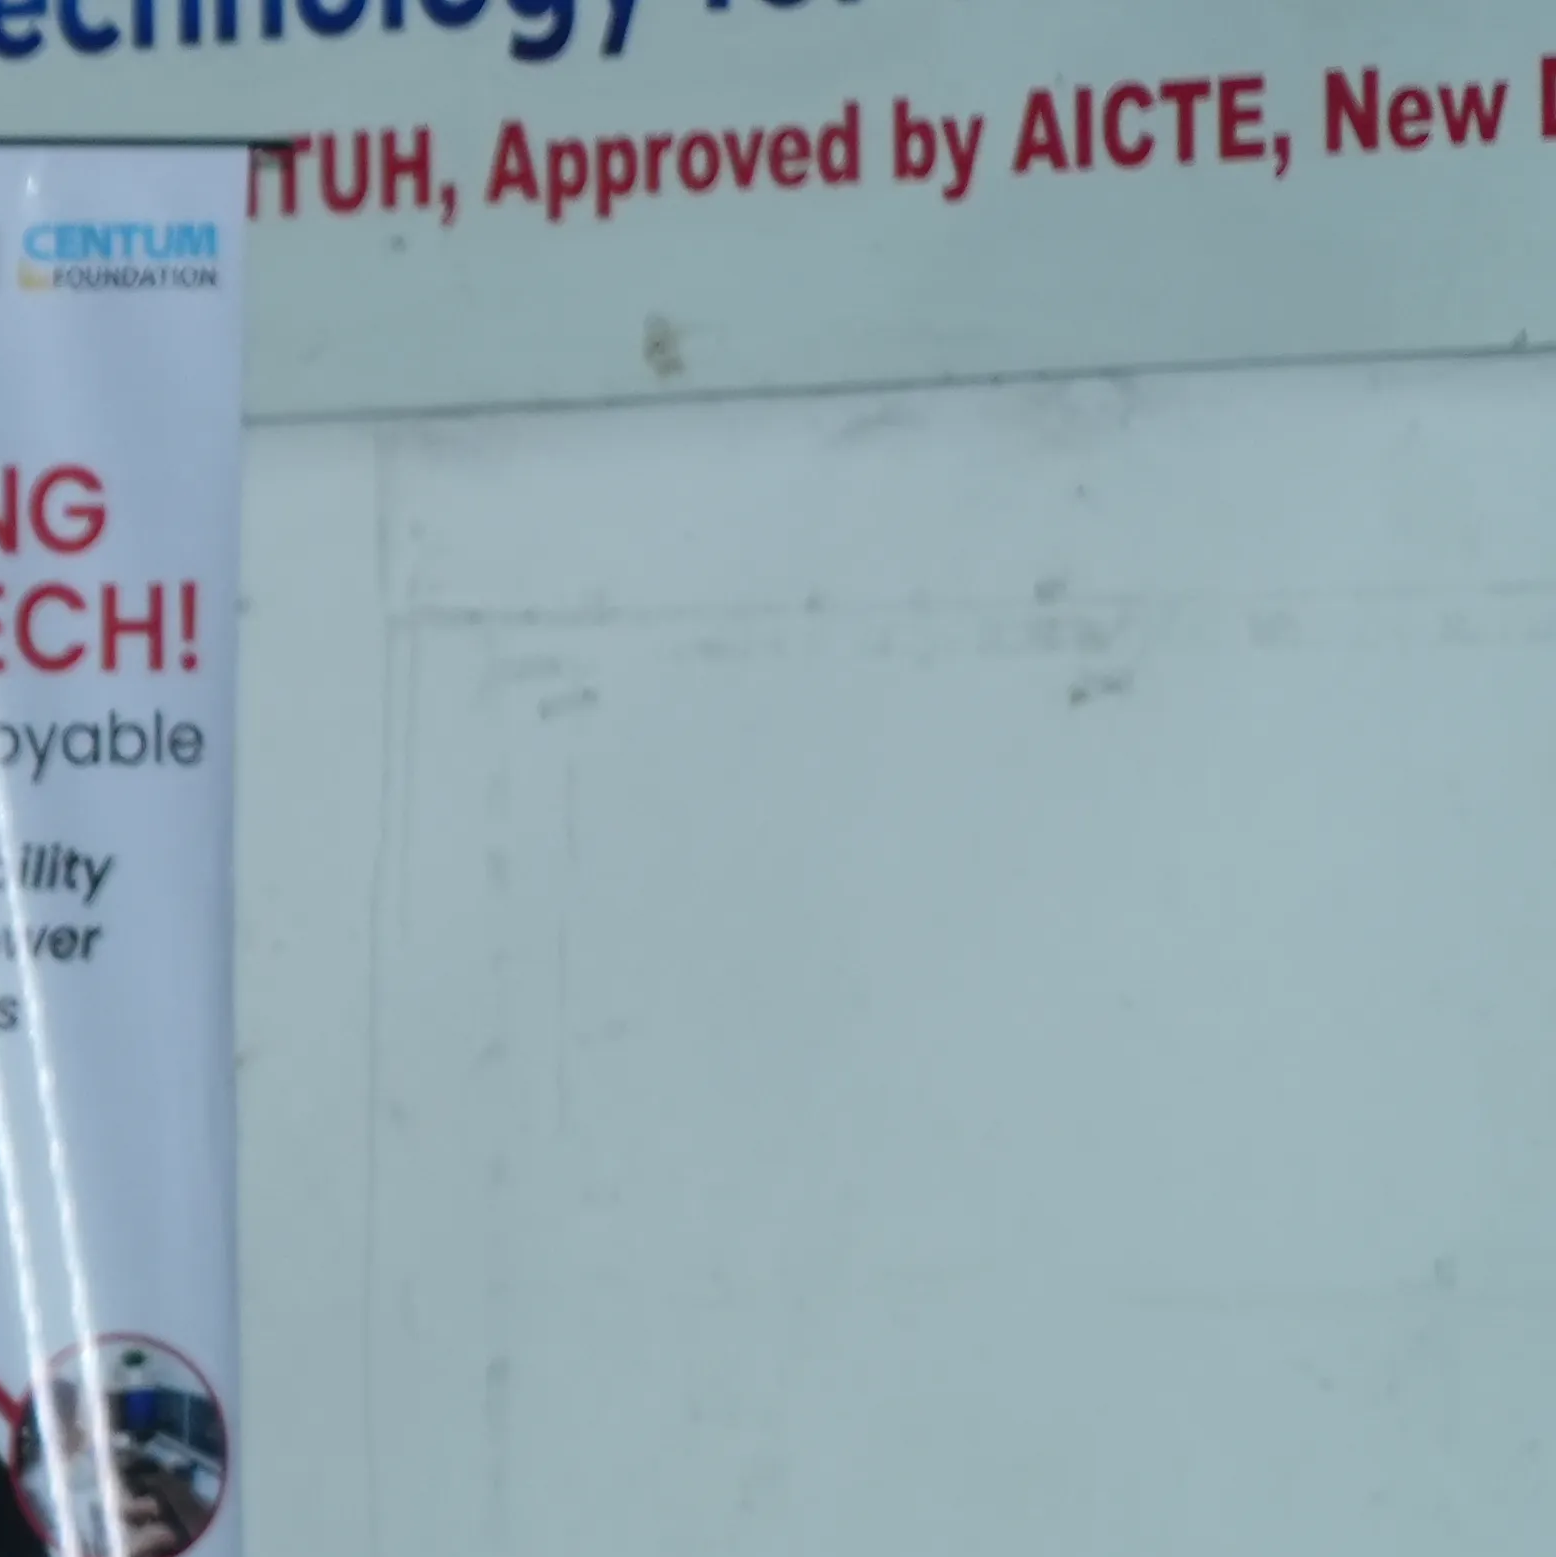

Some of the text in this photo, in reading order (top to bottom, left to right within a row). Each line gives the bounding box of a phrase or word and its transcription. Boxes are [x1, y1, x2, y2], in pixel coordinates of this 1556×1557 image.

[246, 124, 456, 224] TUH,
[485, 104, 859, 222] Approved
[893, 97, 984, 201] by
[1012, 75, 1290, 180] AICTE,
[1325, 66, 1508, 155] New
[22, 220, 218, 262] CENTUM
[51, 263, 219, 290] FOUNDATION
